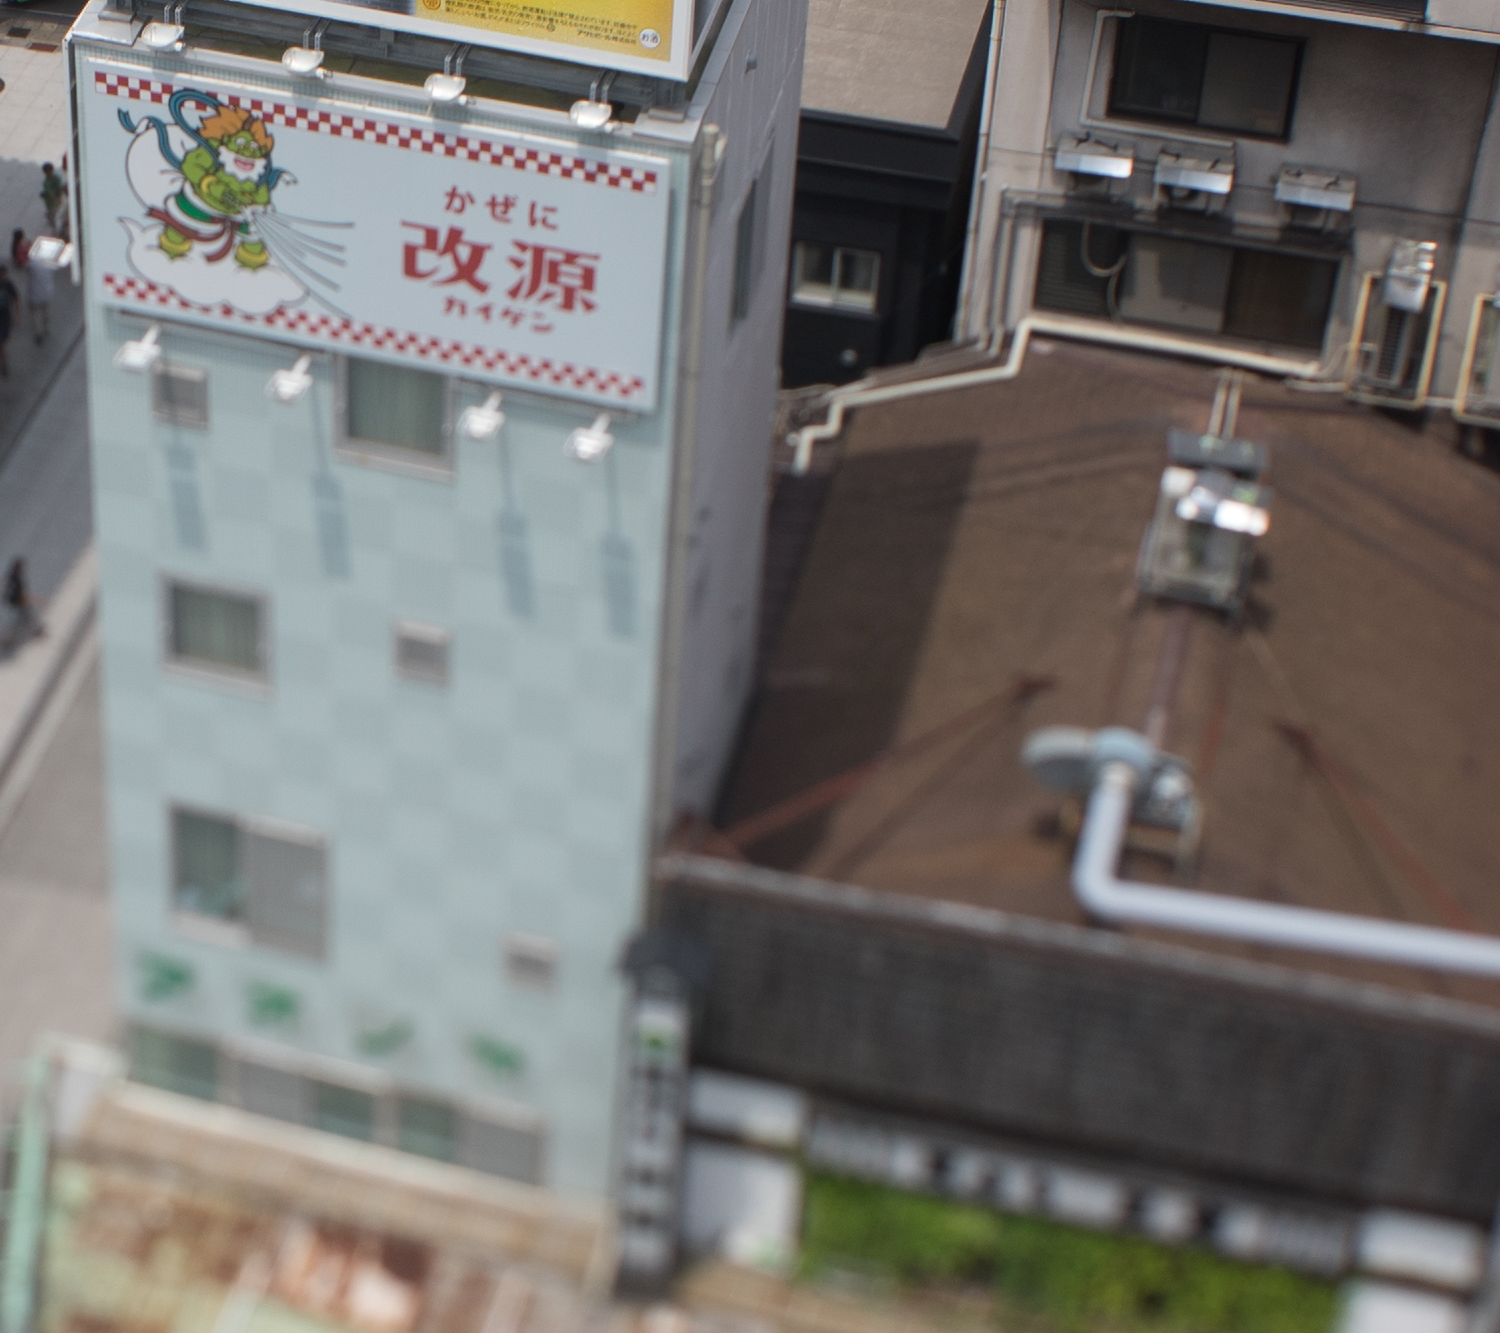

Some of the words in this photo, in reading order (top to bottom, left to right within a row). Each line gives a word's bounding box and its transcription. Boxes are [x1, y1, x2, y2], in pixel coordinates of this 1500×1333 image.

[444, 185, 559, 231] かぜに
[400, 219, 602, 314] 改源
[443, 295, 555, 334] カイゲン
